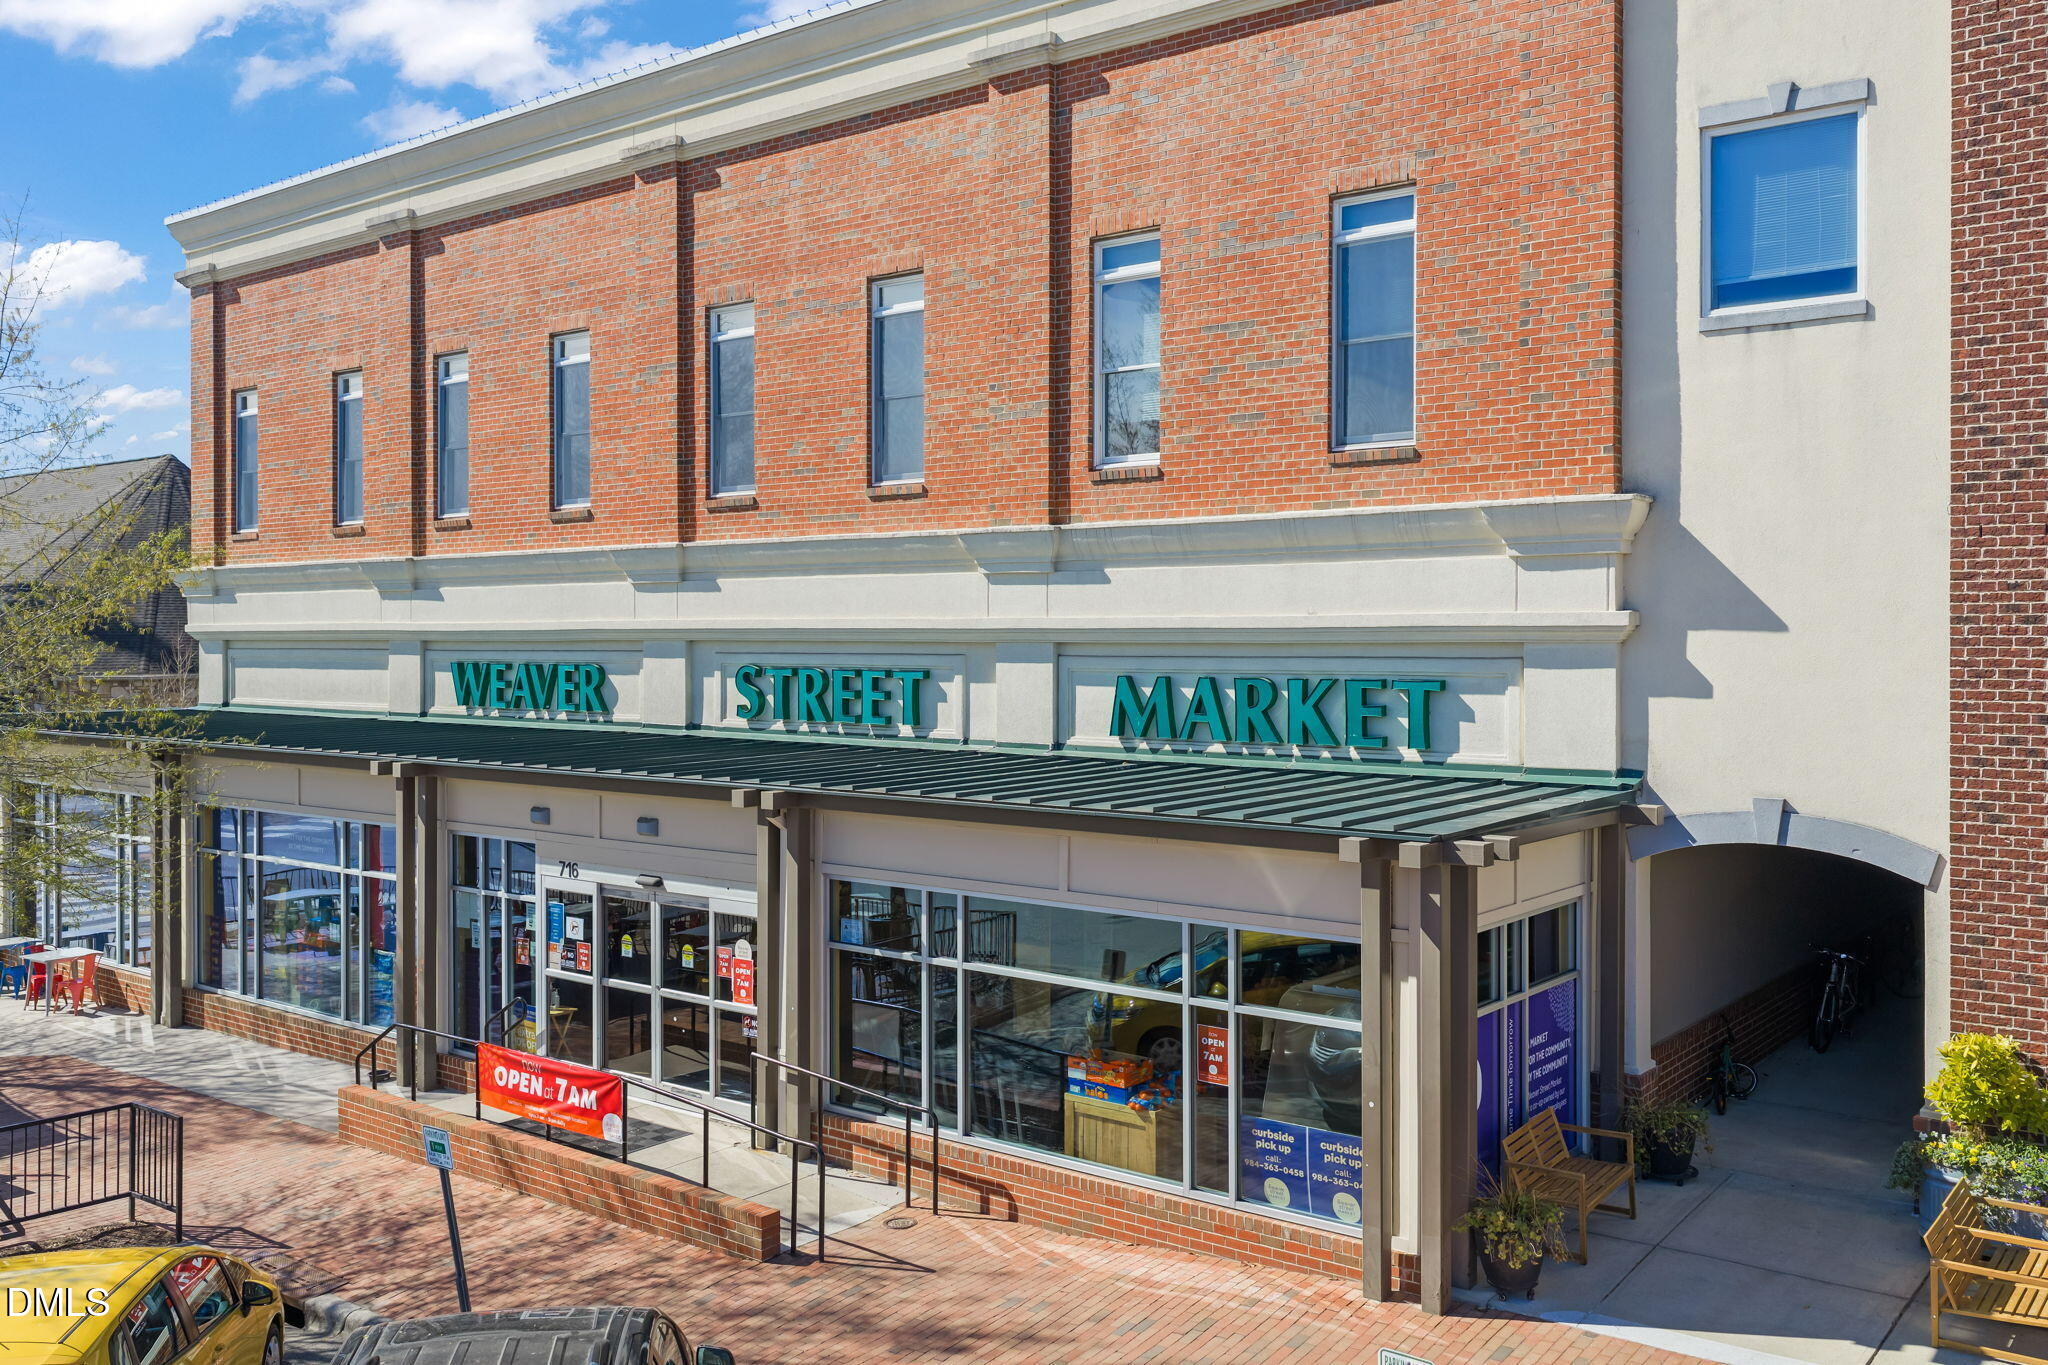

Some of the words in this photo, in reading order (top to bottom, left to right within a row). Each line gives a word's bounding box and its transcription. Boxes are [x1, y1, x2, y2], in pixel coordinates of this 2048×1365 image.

[450, 661, 610, 713] WEAVER
[734, 664, 930, 727] STREET
[1109, 675, 1446, 750] MARKET
[559, 861, 579, 879] 716
[735, 967, 751, 976] OPEN
[736, 978, 750, 987] 7AM
[1201, 1037, 1225, 1048] OPEN
[1530, 1031, 1548, 1048] MARKET
[1203, 1051, 1223, 1063] 7AM
[1528, 1054, 1536, 1065] OR
[1536, 1049, 1545, 1062] THE
[521, 1060, 542, 1074] now
[1532, 1067, 1542, 1080] THE
[1542, 1054, 1569, 1076] COMMUNITY
[494, 1065, 543, 1097] OPEN
[544, 1086, 554, 1100] at
[1251, 1128, 1295, 1143] curbside
[1255, 1139, 1277, 1151] pick
[1278, 1145, 1292, 1155] up
[1265, 1155, 1282, 1163] call:
[1324, 1153, 1346, 1165] pick
[1348, 1159, 1362, 1170] up
[1244, 1158, 1305, 1178] 984-363-0458
[1334, 1169, 1352, 1179] call:
[1311, 1172, 1363, 1190] 984-363-04
